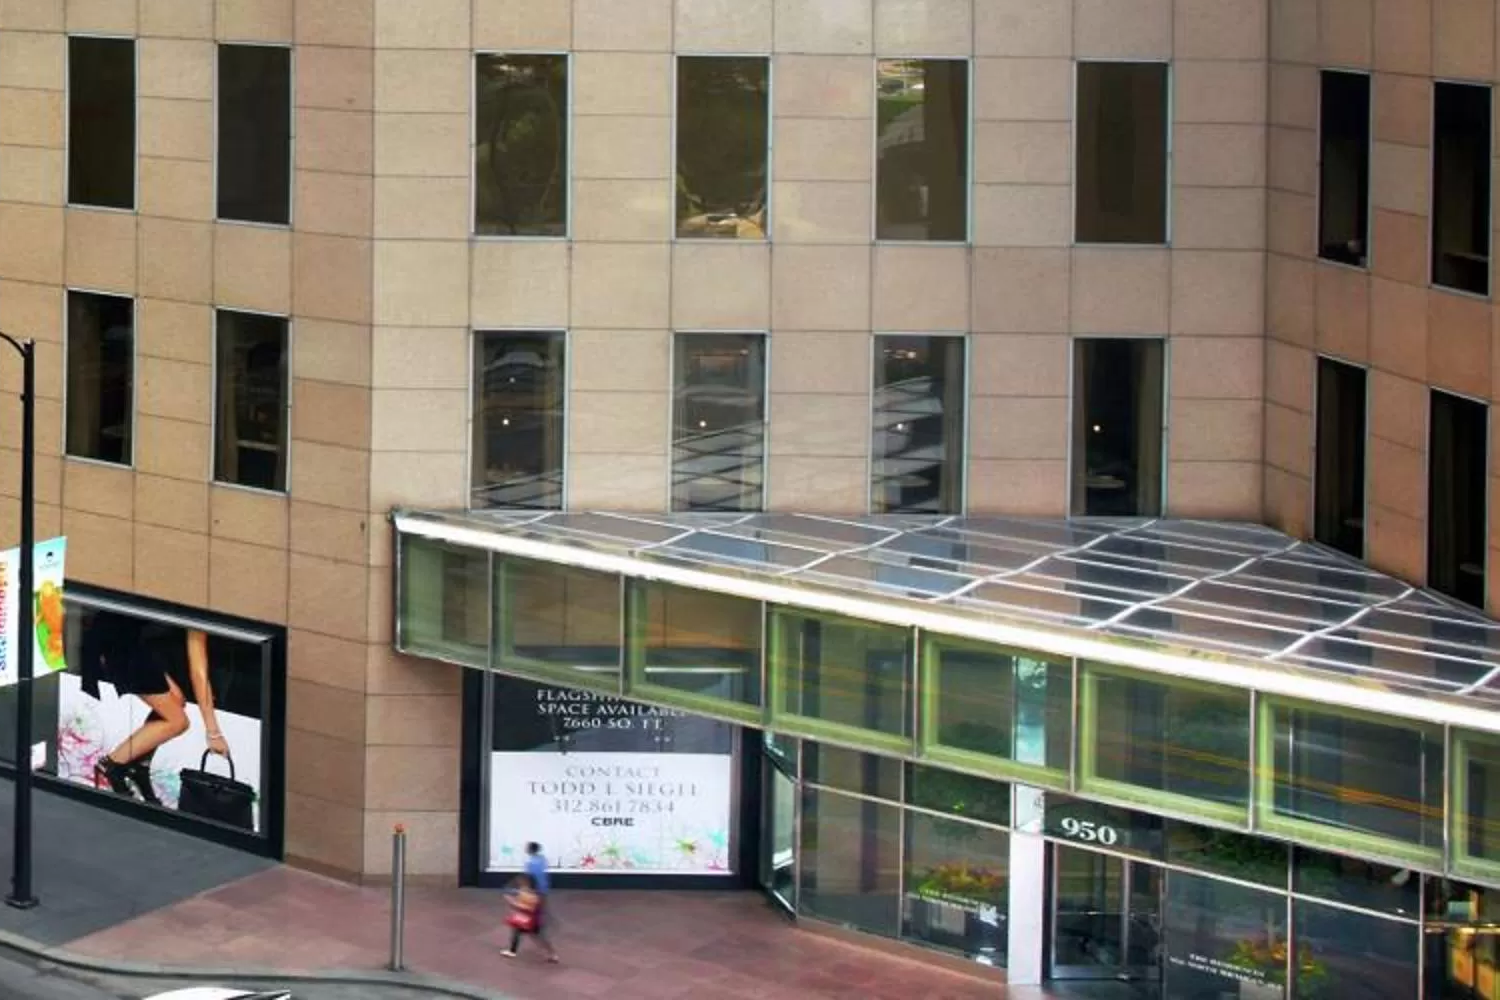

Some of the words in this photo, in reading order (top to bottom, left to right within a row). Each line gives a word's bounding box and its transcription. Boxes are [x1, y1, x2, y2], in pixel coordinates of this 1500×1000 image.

[537, 703, 591, 715] SPACE
[564, 766, 660, 777] CONTACT
[528, 781, 596, 795] TODD
[591, 816, 636, 827] CBRE
[1061, 817, 1117, 845] 950
